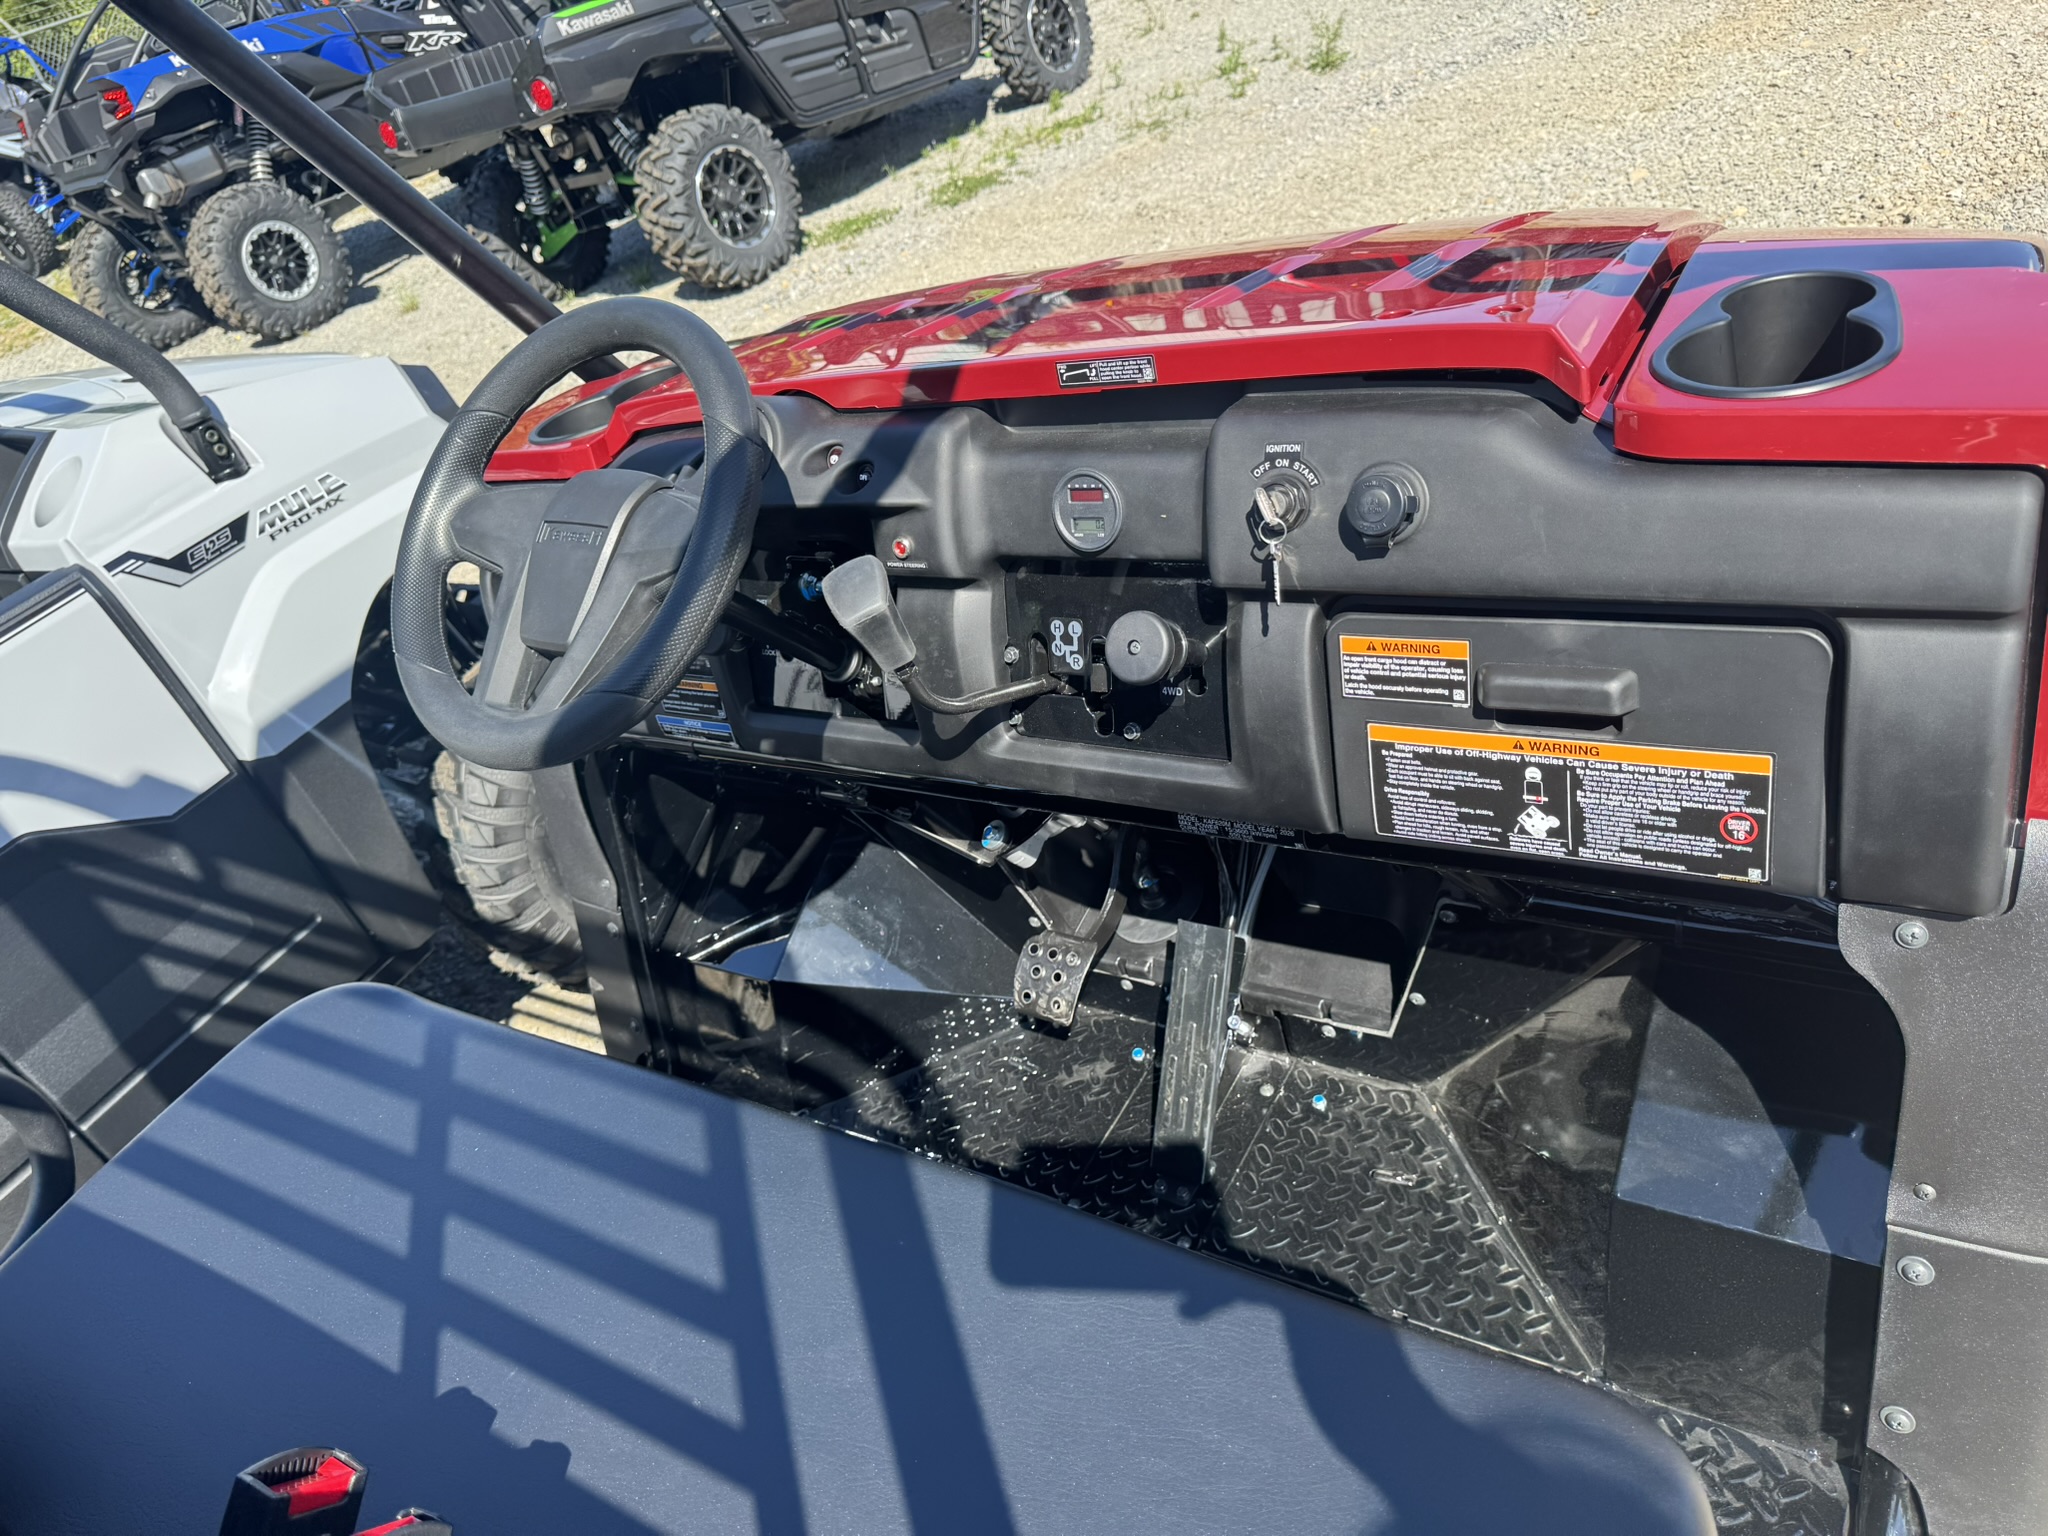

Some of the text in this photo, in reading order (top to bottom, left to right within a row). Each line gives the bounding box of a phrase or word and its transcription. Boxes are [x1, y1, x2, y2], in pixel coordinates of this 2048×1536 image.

[556, 0, 634, 36] Kawasaki
[1266, 444, 1300, 453] IGNITION
[1254, 459, 1318, 486] OFF ON START
[256, 472, 350, 538] MULE
[269, 494, 347, 541] PRO-MX
[187, 527, 232, 565] EPS
[1381, 642, 1440, 654] WARNING
[1162, 686, 1182, 696] 4WD
[1389, 750, 1412, 758] Prepared
[1529, 741, 1599, 756] WARNING
[1394, 743, 1433, 753] Improper
[1465, 749, 1521, 762] Off-Highway
[1523, 754, 1563, 765] Vehicles
[1566, 758, 1584, 767] Can
[1588, 760, 1618, 770] Cause
[1621, 763, 1655, 773] Severe
[1658, 767, 1687, 778] Injury
[1704, 770, 1734, 780] Death
[1600, 770, 1633, 779] Occupants
[1646, 774, 1675, 782] Attention
[1398, 787, 1429, 797] Responsibly
[1576, 796, 1599, 804] Require
[1638, 796, 1661, 805] Parking
[1703, 802, 1728, 812] Leaving
[1740, 806, 1766, 814] Vehicle.
[1234, 823, 1256, 831] MODEL
[1731, 830, 1745, 840] 16
[1594, 848, 1618, 856] Owner's
[1619, 851, 1642, 859] Manual.
[1608, 855, 1642, 864] Instructions
[1656, 862, 1687, 870] Warnings.
